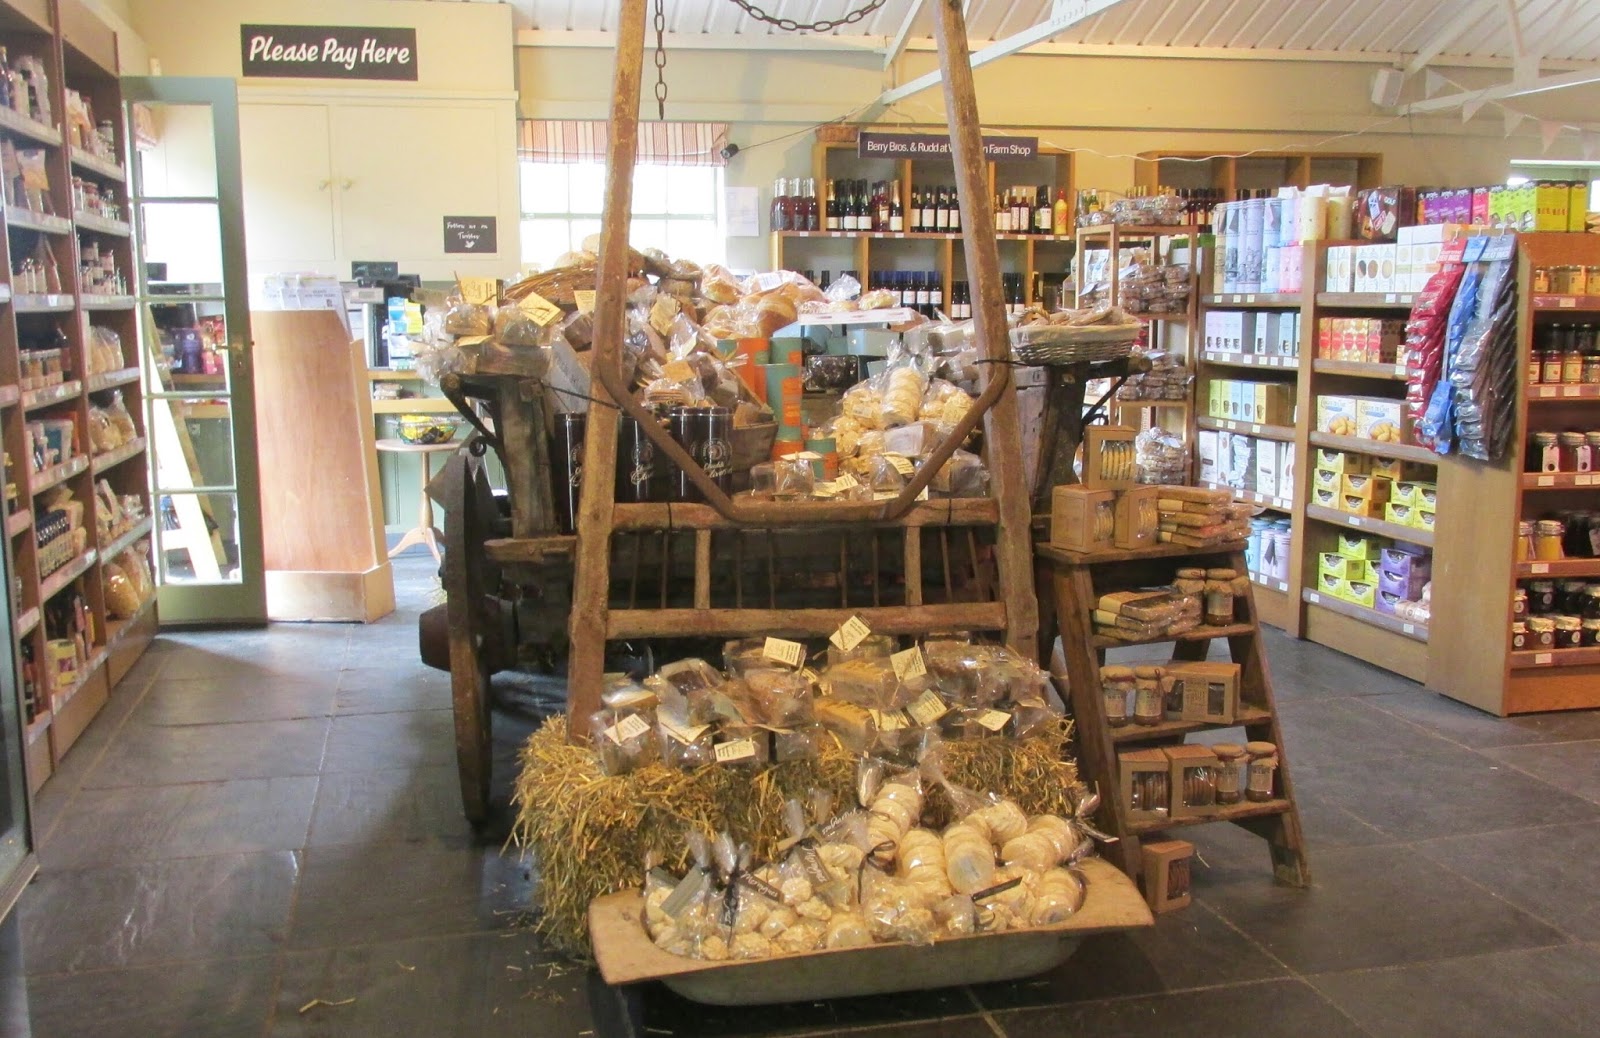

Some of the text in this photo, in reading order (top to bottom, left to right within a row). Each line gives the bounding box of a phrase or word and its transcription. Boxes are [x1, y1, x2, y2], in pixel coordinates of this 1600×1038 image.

[249, 36, 410, 70] Please Pay Here
[867, 141, 888, 153] Berry
[889, 141, 909, 152] Bros.
[910, 142, 917, 152] &
[918, 142, 939, 152] Rudd
[940, 143, 948, 153] at
[989, 144, 1009, 154] Farm
[1010, 145, 1031, 156] Shop
